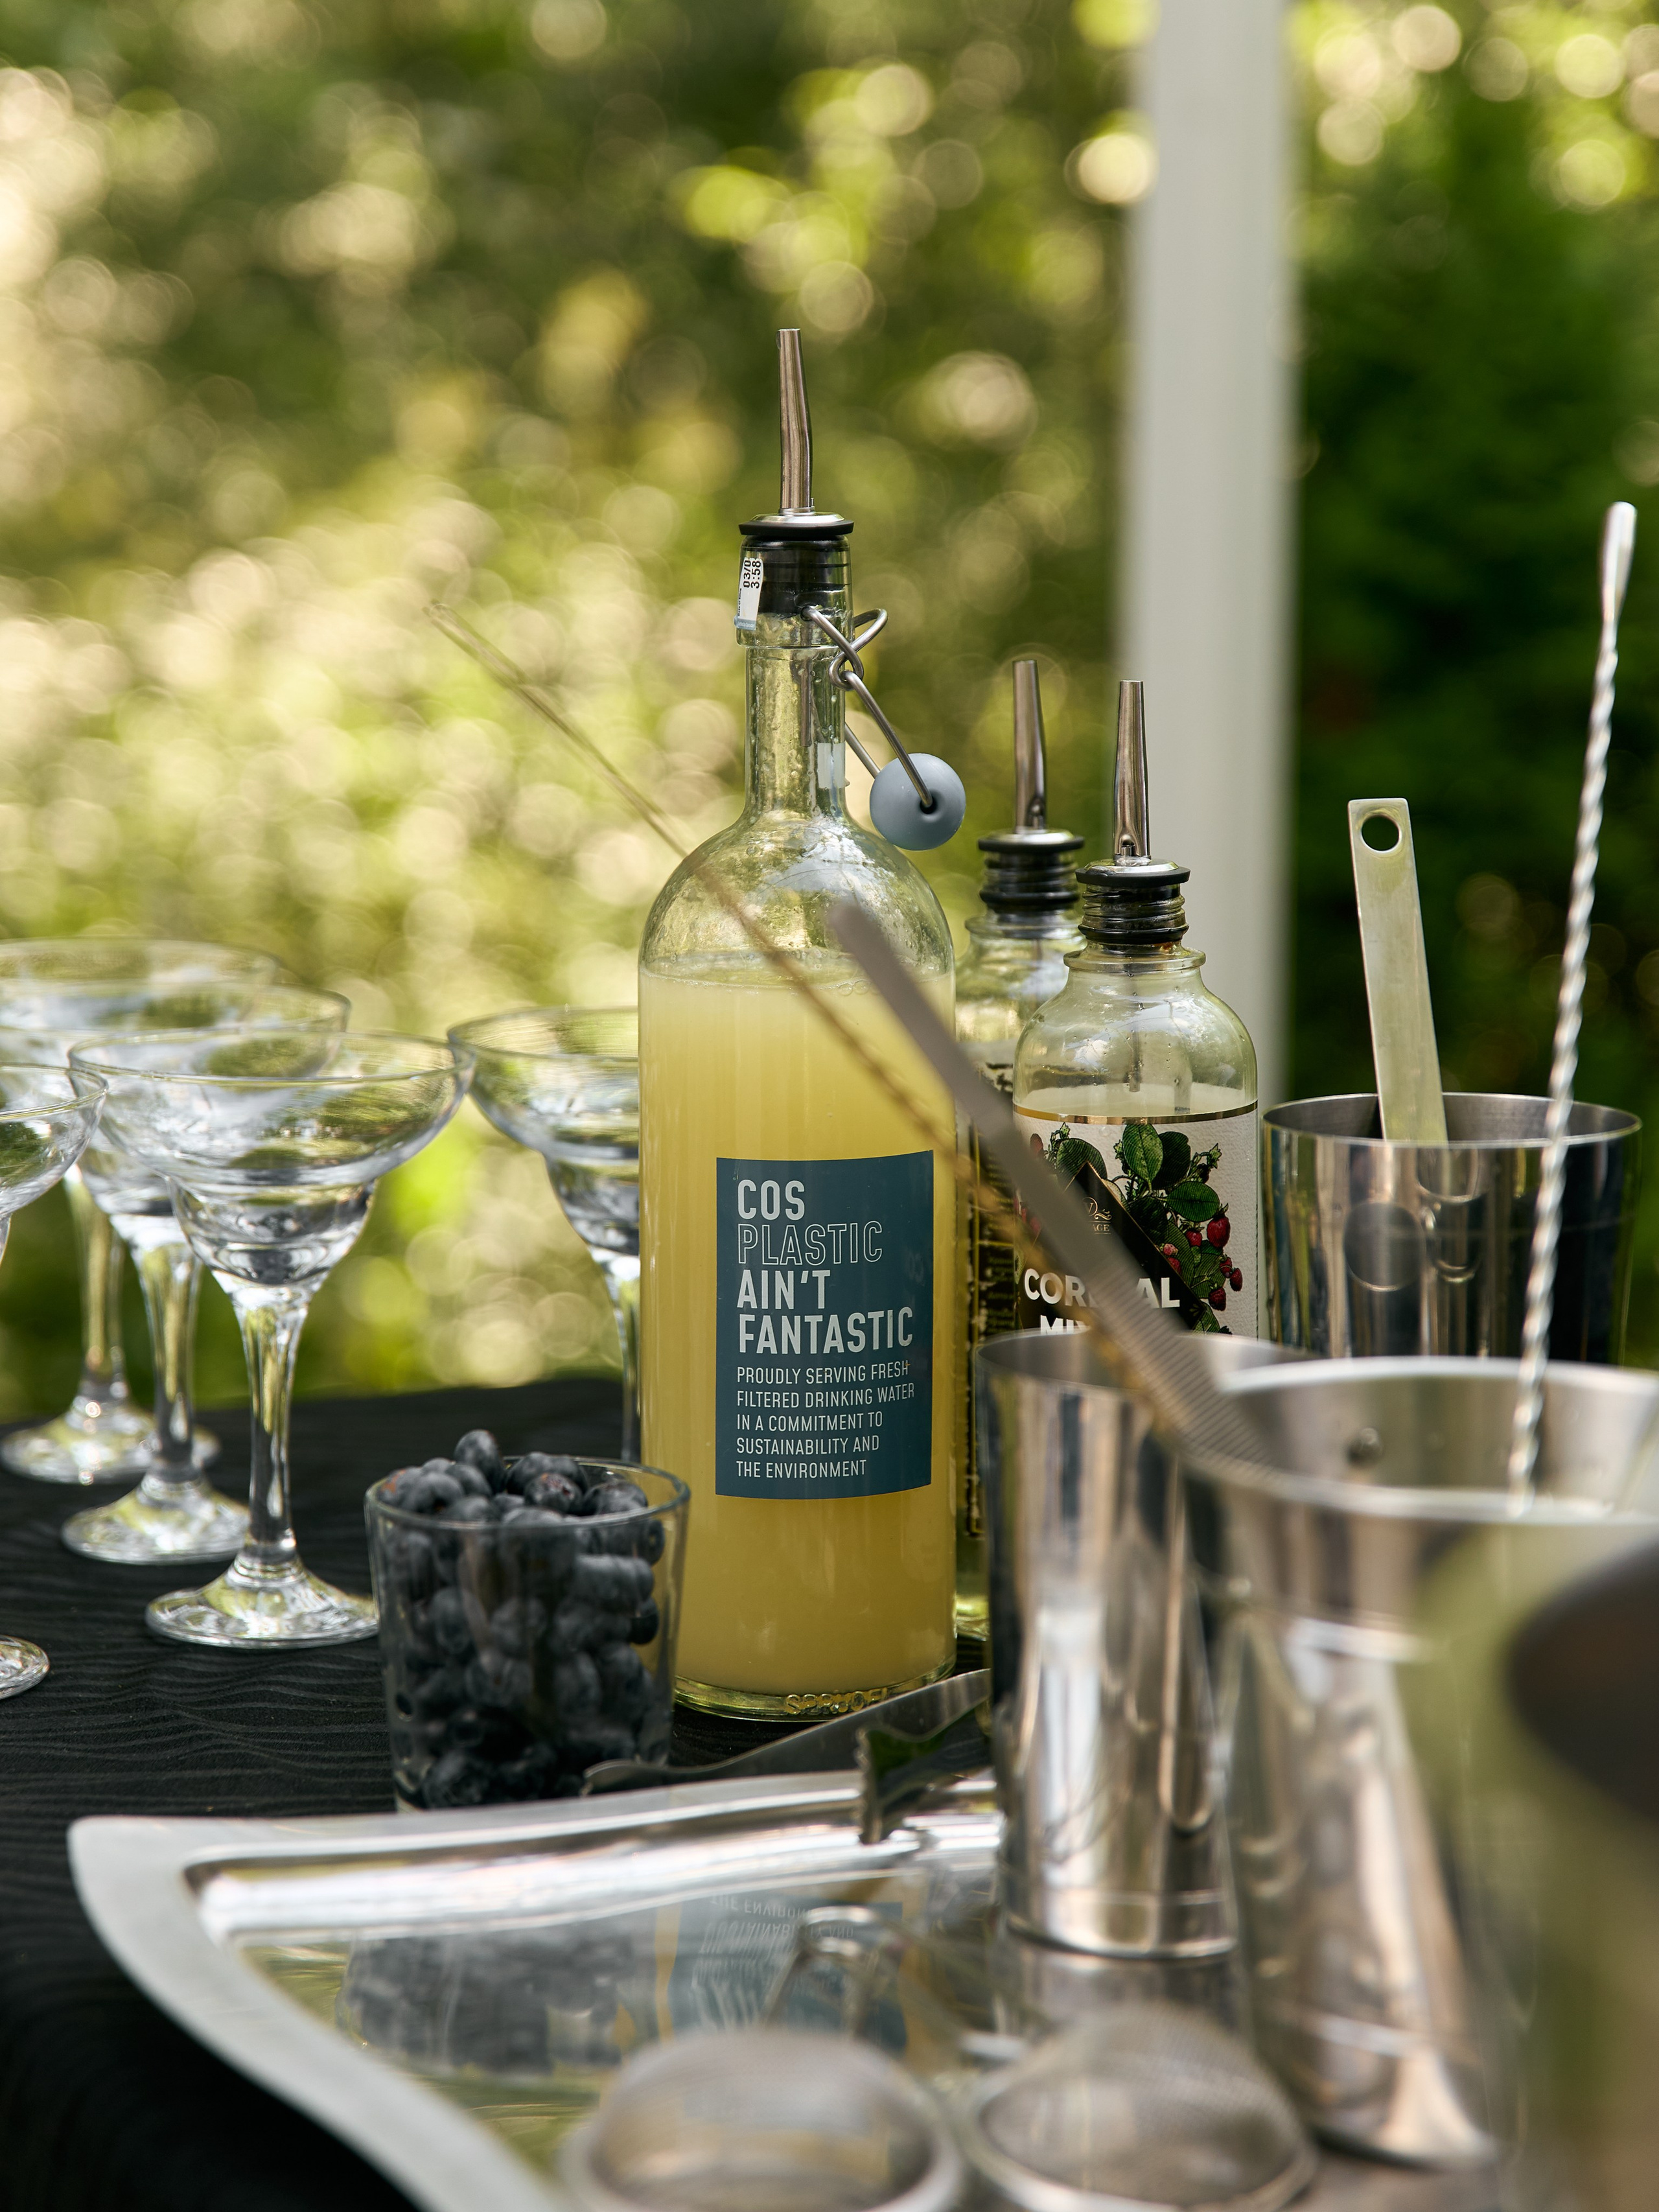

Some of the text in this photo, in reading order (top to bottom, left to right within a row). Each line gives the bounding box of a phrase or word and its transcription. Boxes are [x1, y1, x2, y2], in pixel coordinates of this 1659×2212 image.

[737, 1179, 805, 1220] COS
[737, 1220, 883, 1266] PLASTIC
[736, 1269, 831, 1310] AIN'T
[1024, 1268, 1180, 1309] CORAL
[739, 1307, 913, 1355] FANTASTIC
[737, 1360, 909, 1385] PROUDLY SERVING FRESH
[737, 1382, 914, 1408] FILTERED DRINKING WATER
[737, 1411, 883, 1432] IN A COMMITMENT TO
[737, 1435, 879, 1455] SUSTAINABILITY AND
[736, 1460, 866, 1478] THE ENVIRONMENT
